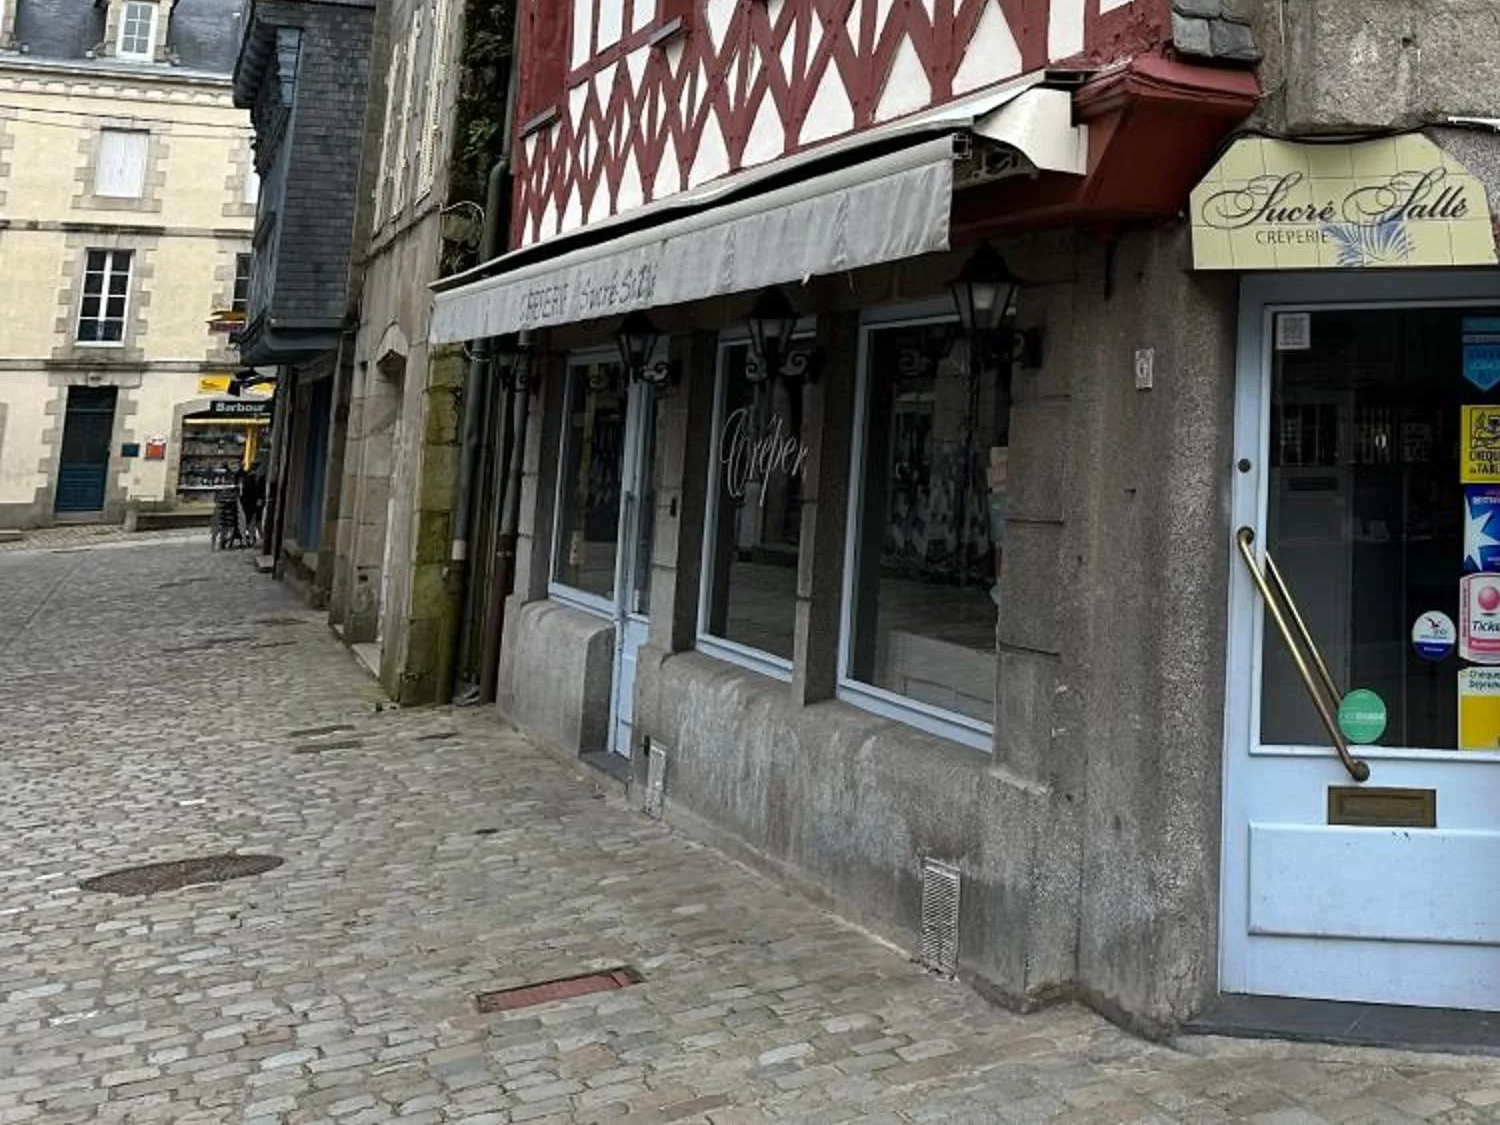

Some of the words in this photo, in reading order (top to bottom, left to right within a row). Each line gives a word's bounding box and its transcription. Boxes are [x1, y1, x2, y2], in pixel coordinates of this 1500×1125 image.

[1202, 171, 1335, 229] Sucré
[1342, 166, 1469, 227] Sallé
[215, 402, 266, 412] Barbour
